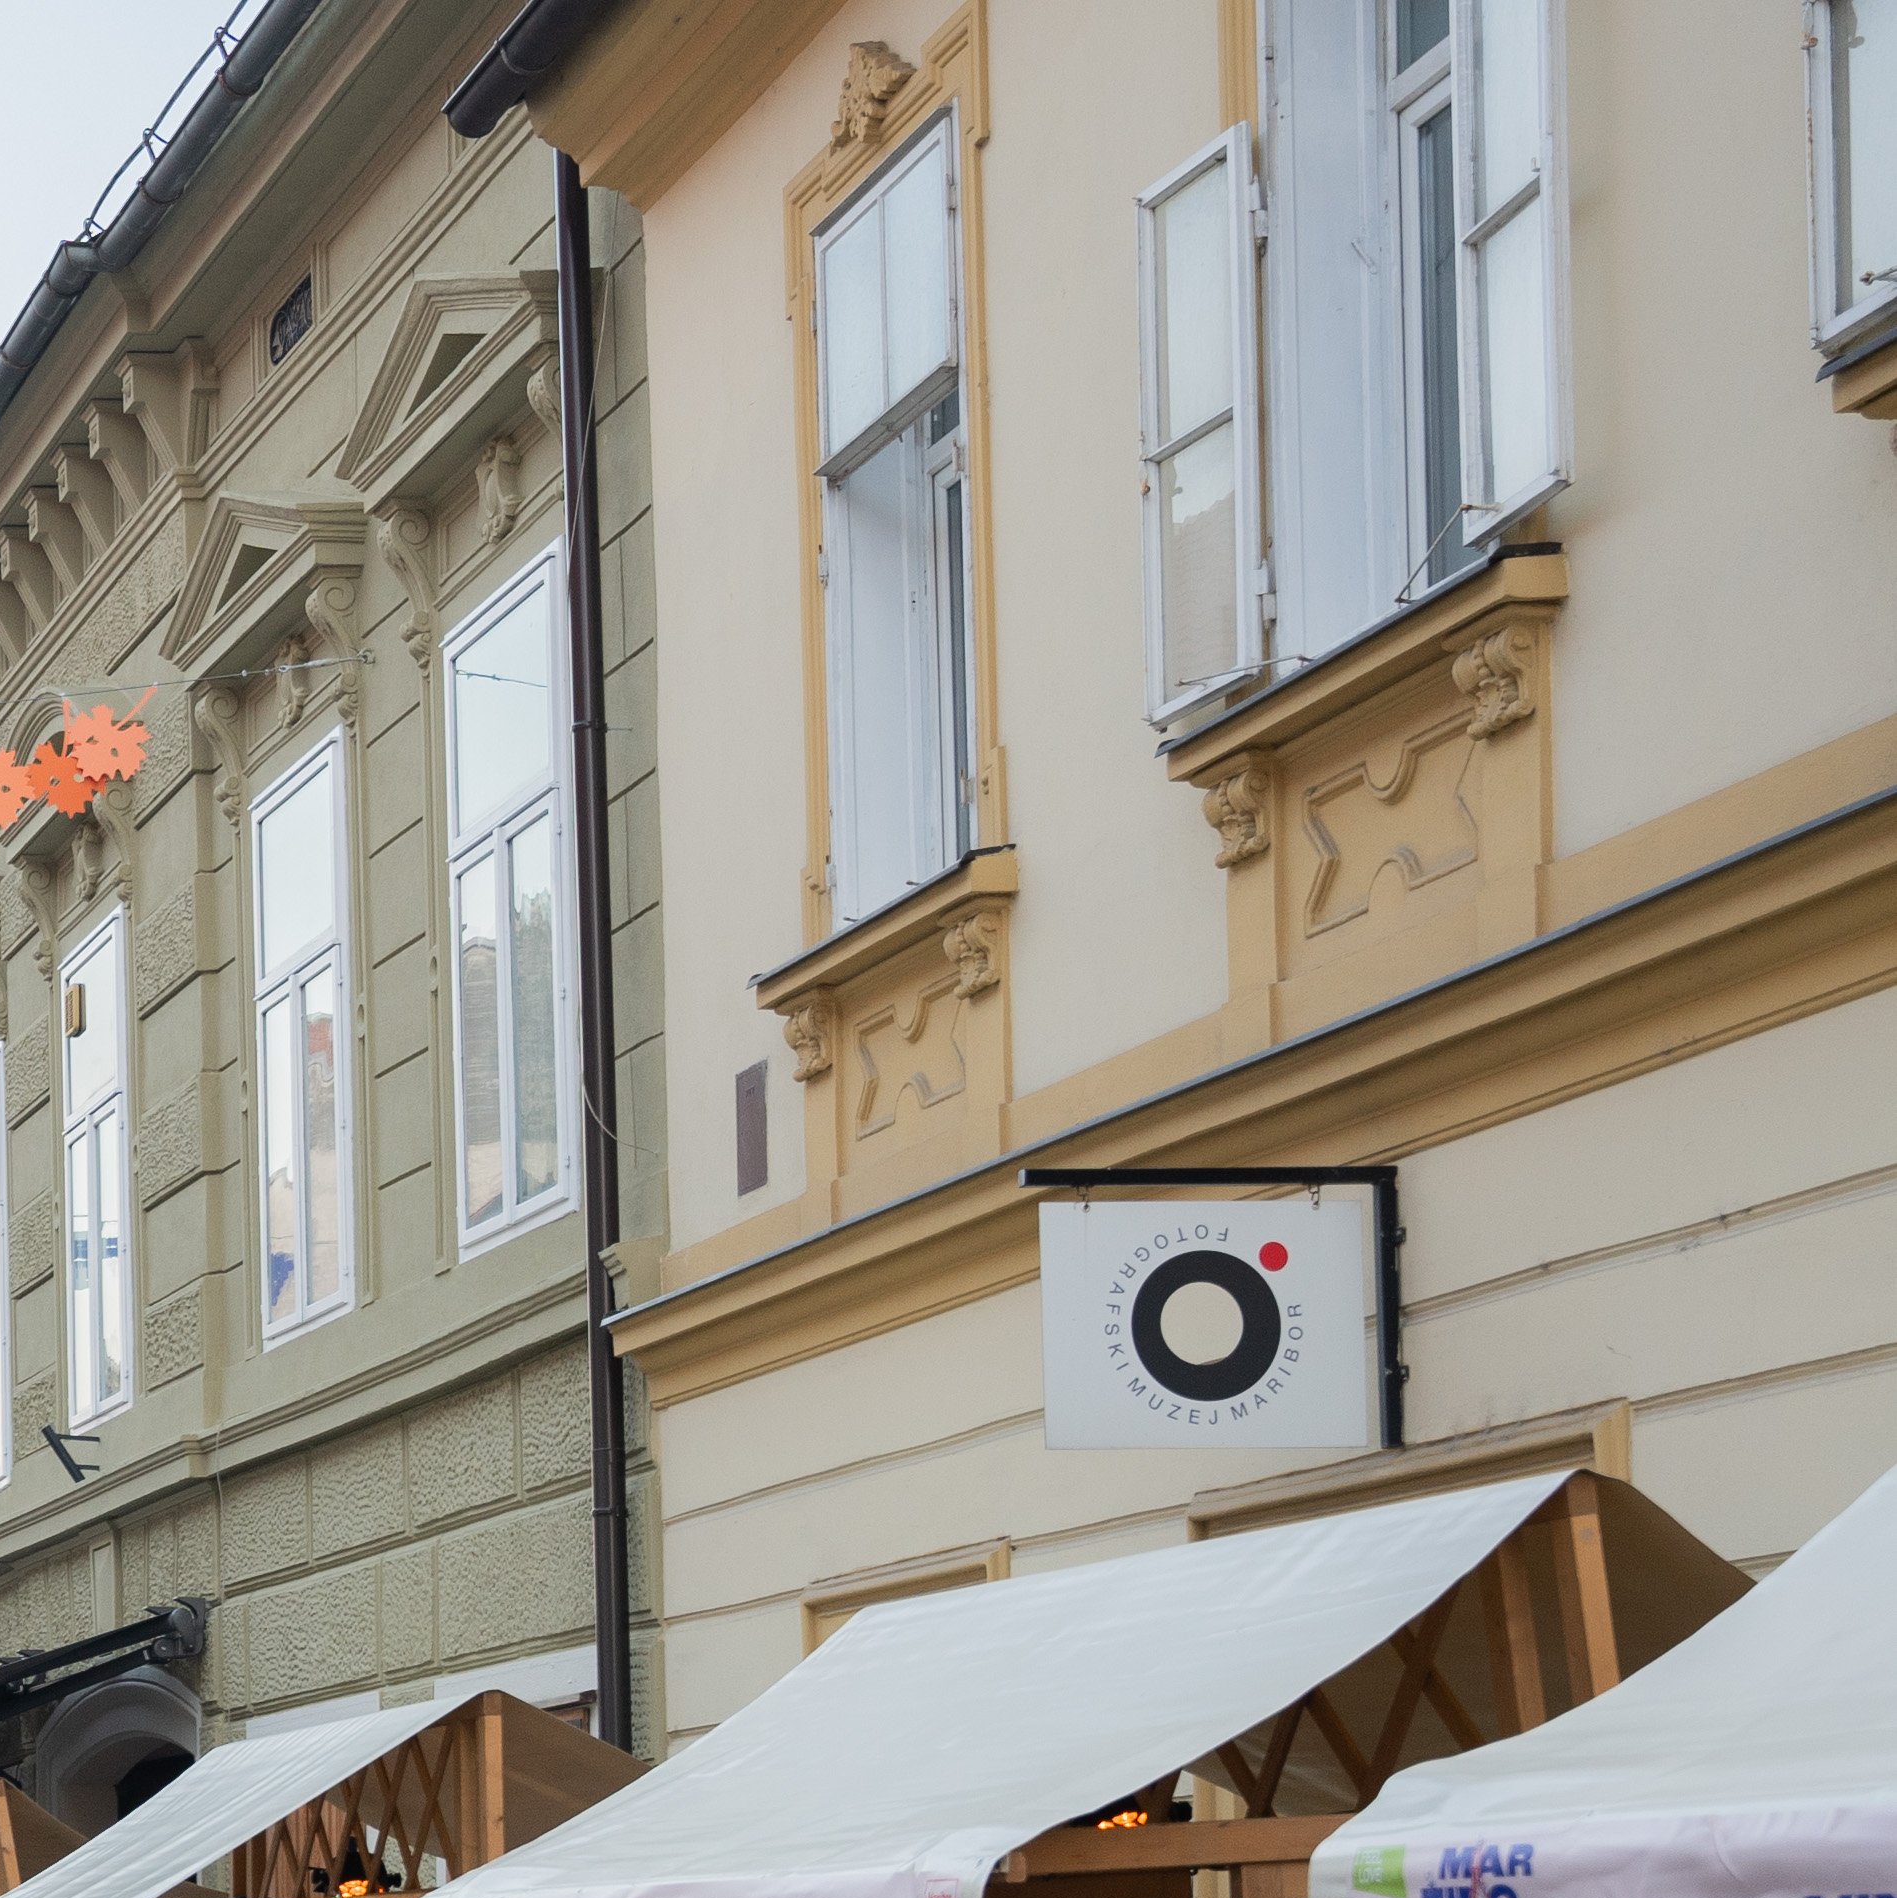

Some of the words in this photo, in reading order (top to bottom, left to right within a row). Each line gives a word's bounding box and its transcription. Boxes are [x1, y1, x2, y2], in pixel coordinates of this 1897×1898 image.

[1104, 1224, 1229, 1372] FOTOGRAFSKI
[1127, 1377, 1219, 1426] MUZEJ
[1230, 1302, 1304, 1423] MARIBOR
[1438, 1844, 1535, 1880] MAR
